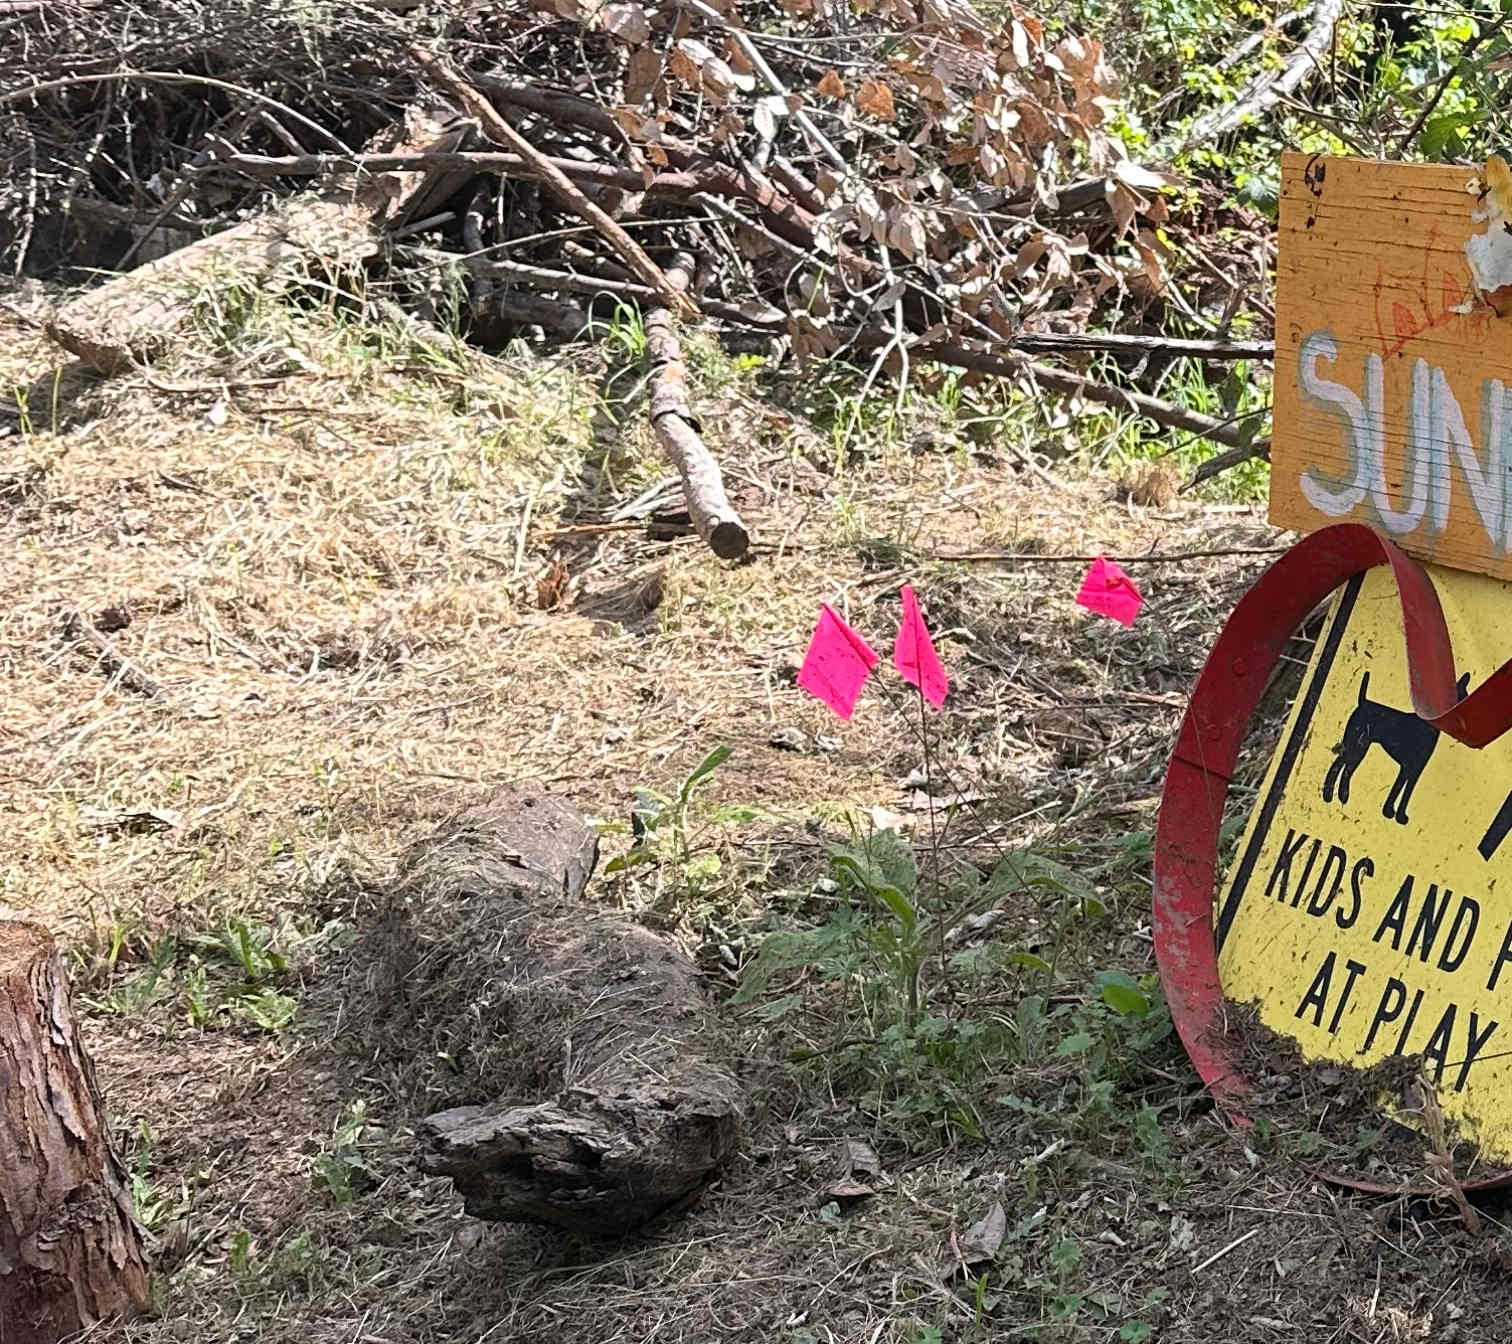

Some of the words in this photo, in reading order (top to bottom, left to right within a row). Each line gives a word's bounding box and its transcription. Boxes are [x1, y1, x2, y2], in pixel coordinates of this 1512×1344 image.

[1264, 829, 1374, 929] KIDS
[1373, 874, 1480, 973] AND
[1295, 952, 1367, 1034] AT
